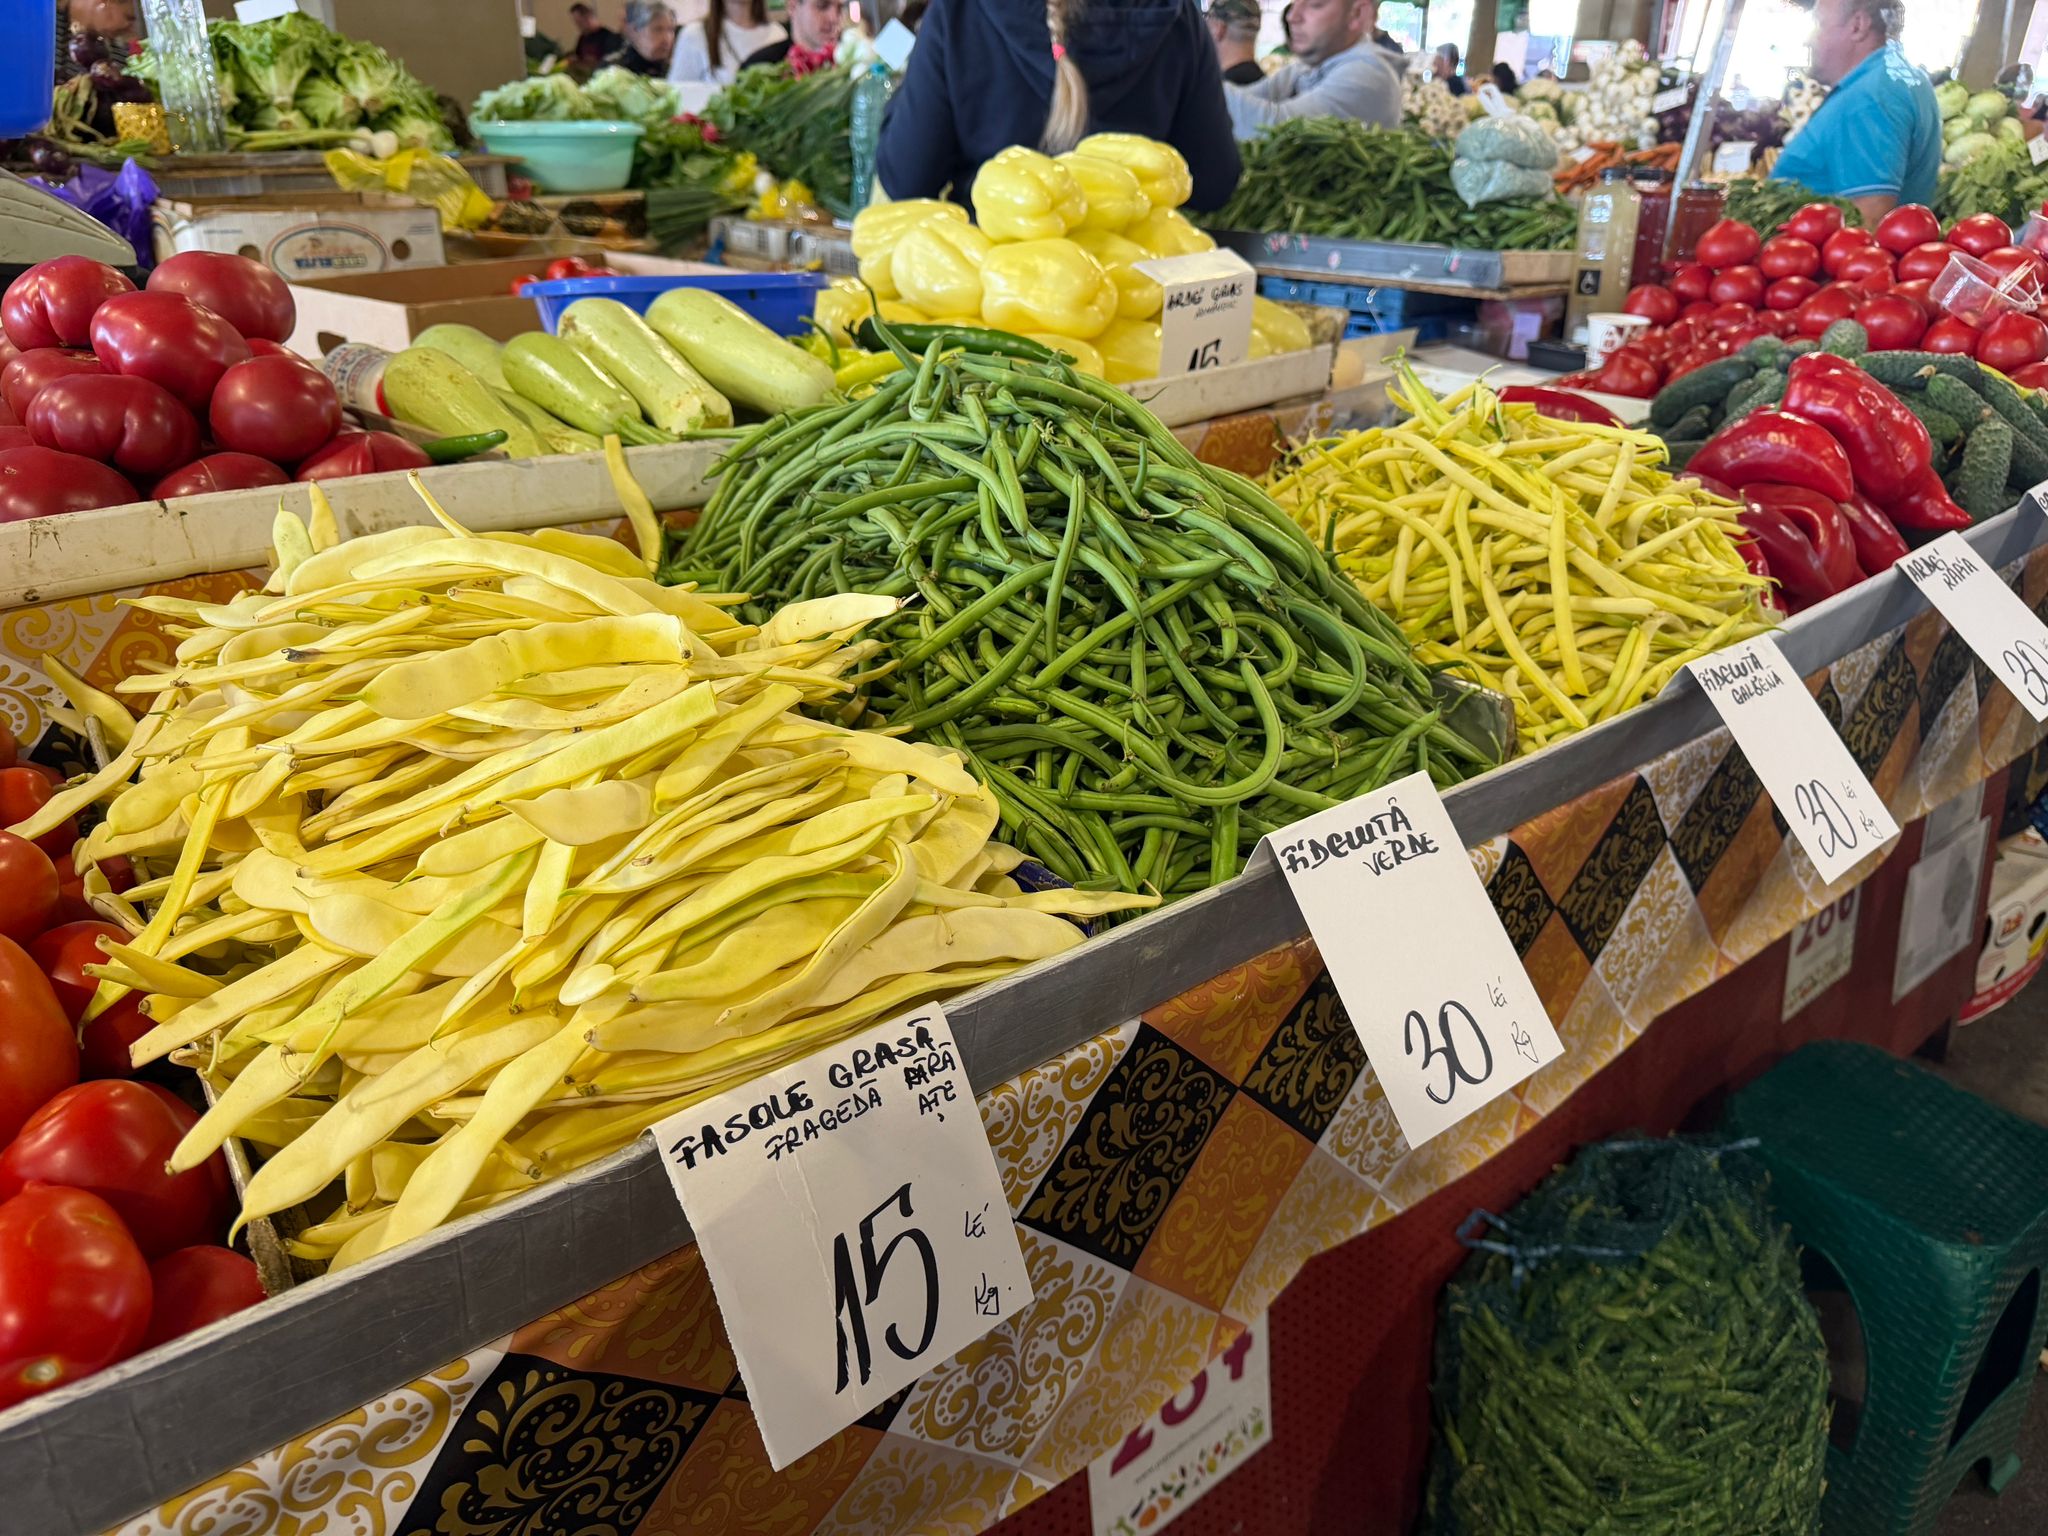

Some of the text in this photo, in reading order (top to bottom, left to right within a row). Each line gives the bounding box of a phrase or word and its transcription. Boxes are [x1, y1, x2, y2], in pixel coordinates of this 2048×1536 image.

[1795, 779, 1857, 858] 30
[1404, 1000, 1493, 1105] 30
[834, 1182, 940, 1395] 15
